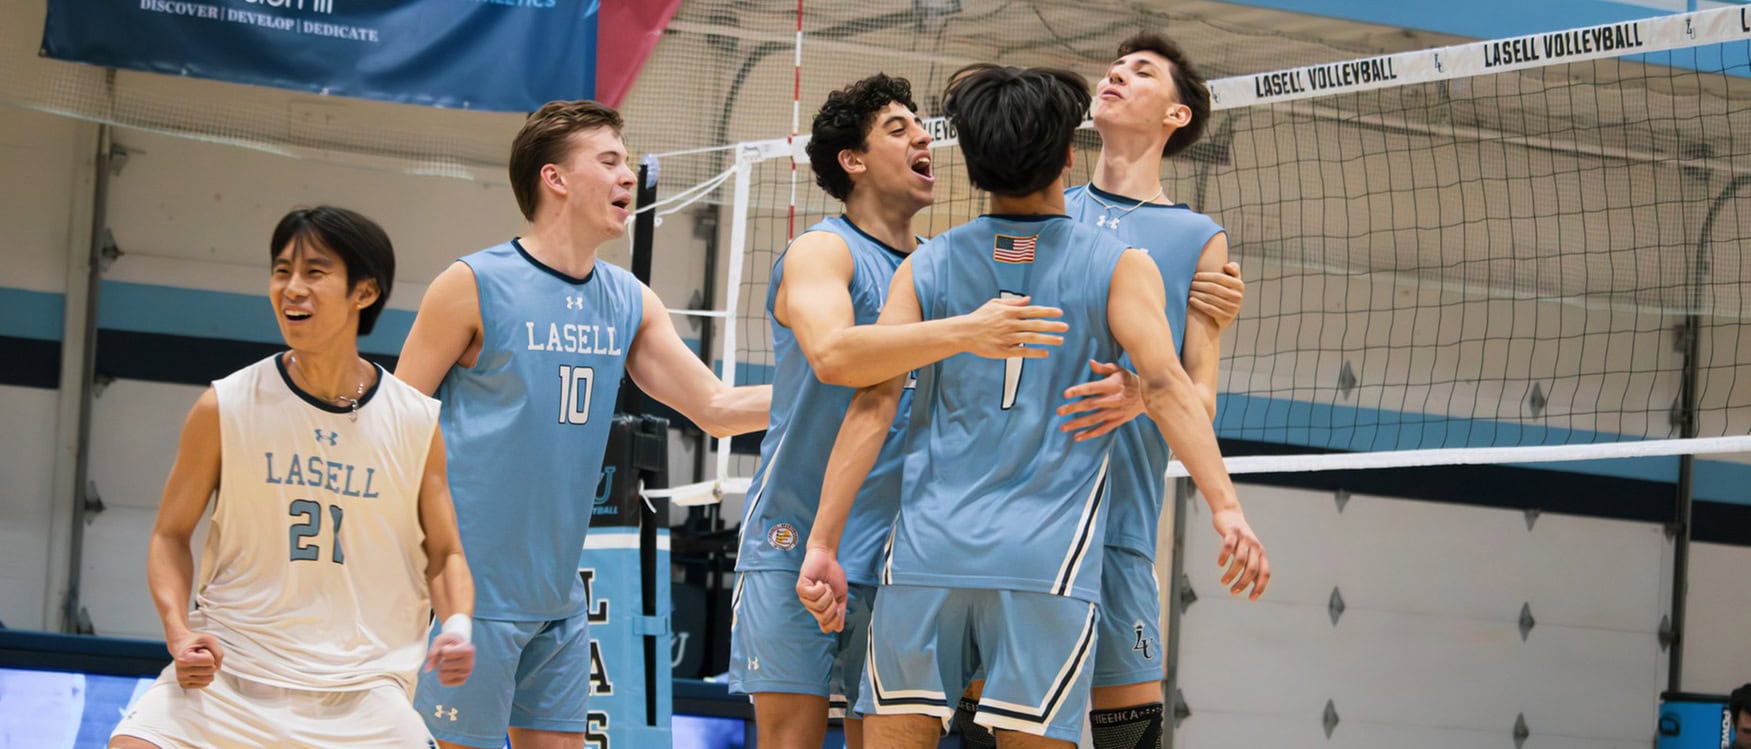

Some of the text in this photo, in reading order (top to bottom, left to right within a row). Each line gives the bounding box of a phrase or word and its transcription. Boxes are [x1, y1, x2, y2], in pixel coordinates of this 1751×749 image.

[140, 0, 379, 42] DISCOVER DEVELOP DEDICATE
[1484, 22, 1643, 67] LASELL VOLLEYBALL
[1255, 56, 1397, 98] LASELL VOLLEYBALL
[525, 321, 621, 356] LASELL
[558, 365, 594, 425] 10
[264, 451, 379, 498] LASELL
[288, 498, 344, 565] 21
